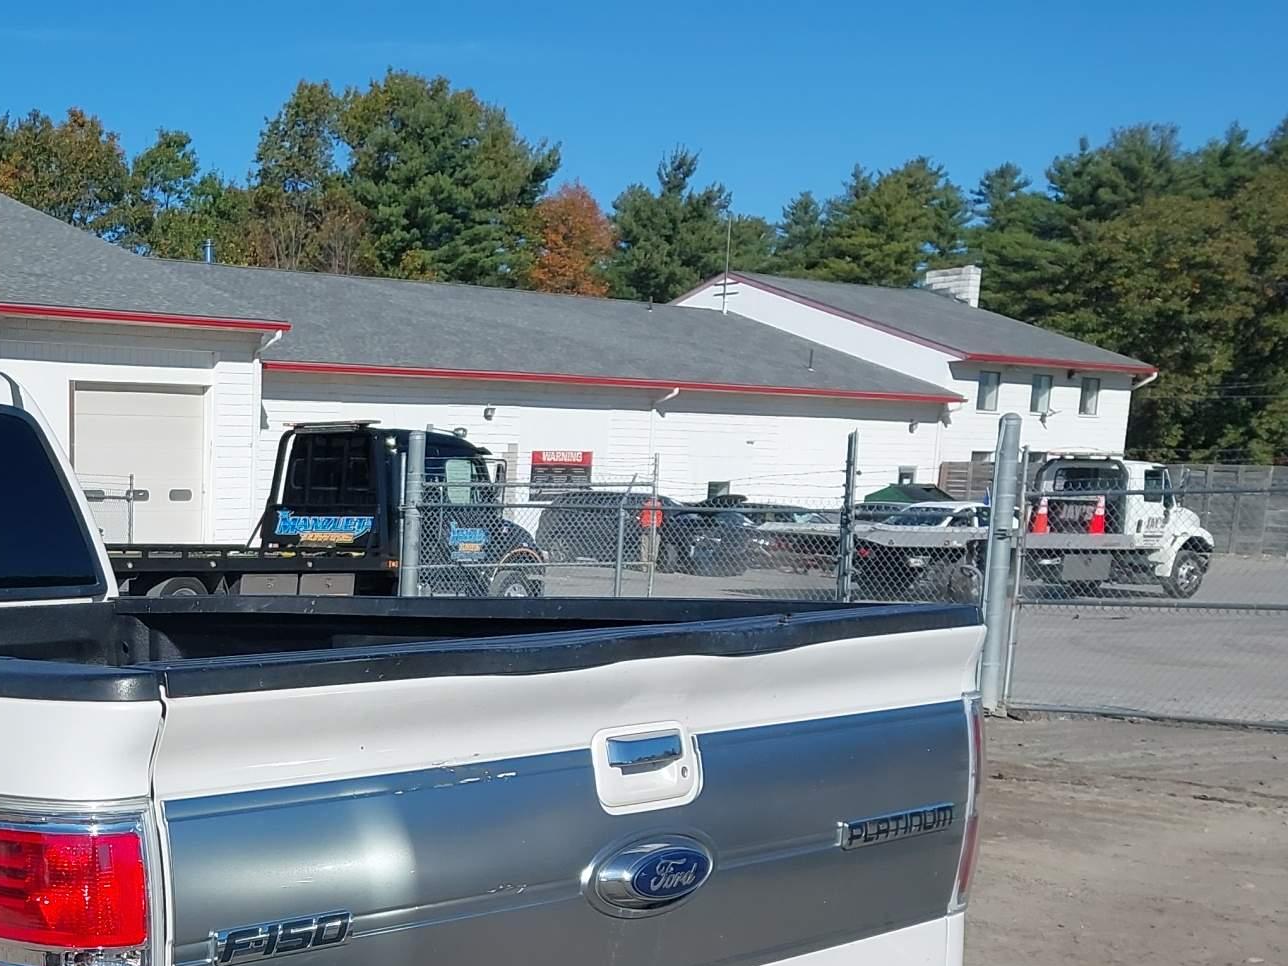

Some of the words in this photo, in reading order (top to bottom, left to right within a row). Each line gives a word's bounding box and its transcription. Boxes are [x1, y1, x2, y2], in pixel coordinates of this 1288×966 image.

[542, 451, 583, 462] WARNING
[848, 805, 953, 846] PLATINUM
[650, 856, 698, 891] Ford
[220, 911, 351, 963] F-150
